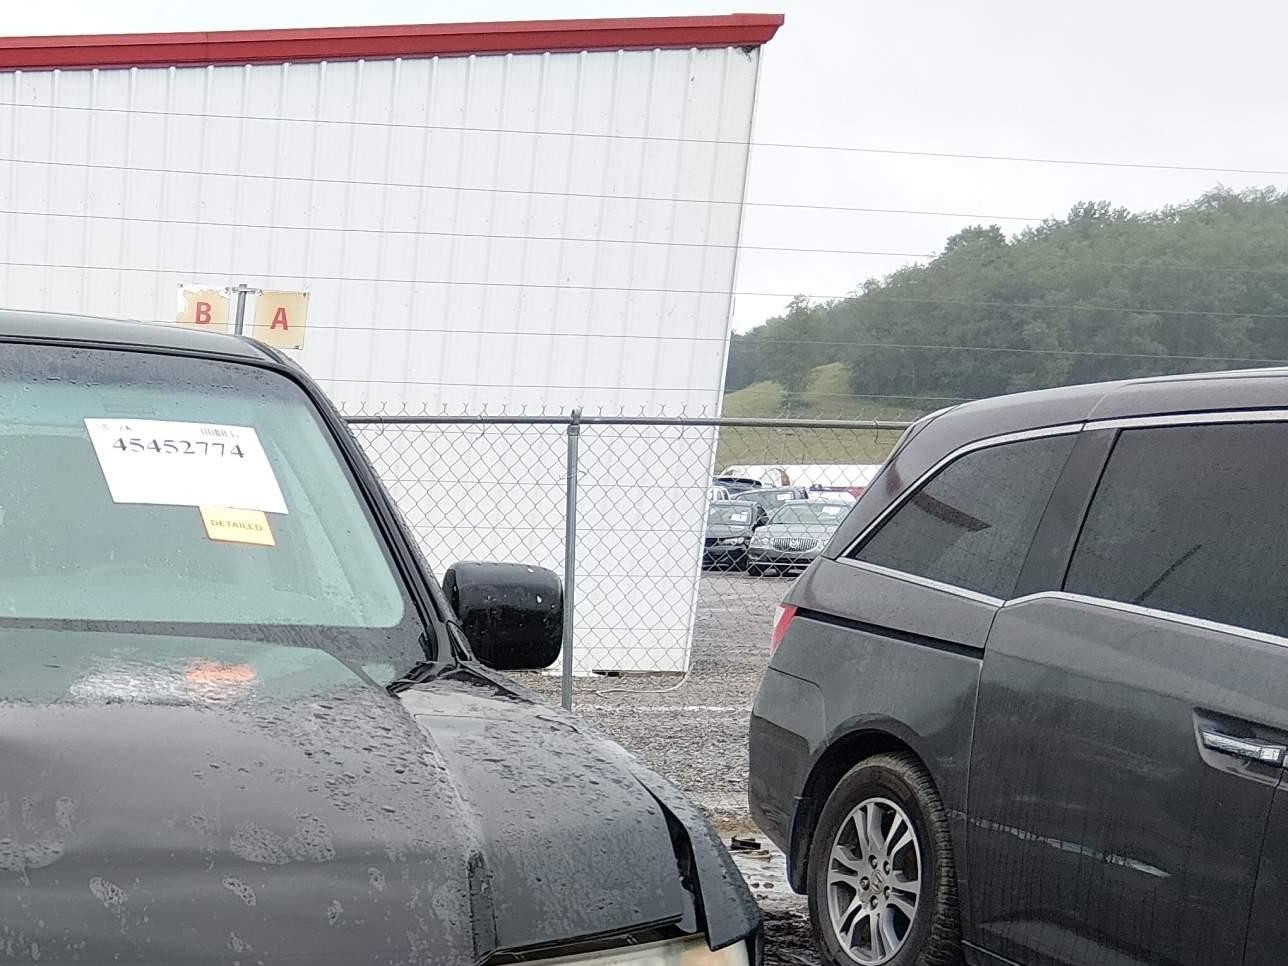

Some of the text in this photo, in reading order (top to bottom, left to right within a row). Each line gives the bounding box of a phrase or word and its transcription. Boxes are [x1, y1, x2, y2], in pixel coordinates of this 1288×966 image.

[195, 301, 212, 325] B
[269, 307, 289, 331] A
[112, 437, 245, 458] 45452774
[210, 519, 263, 531] DETAILED
